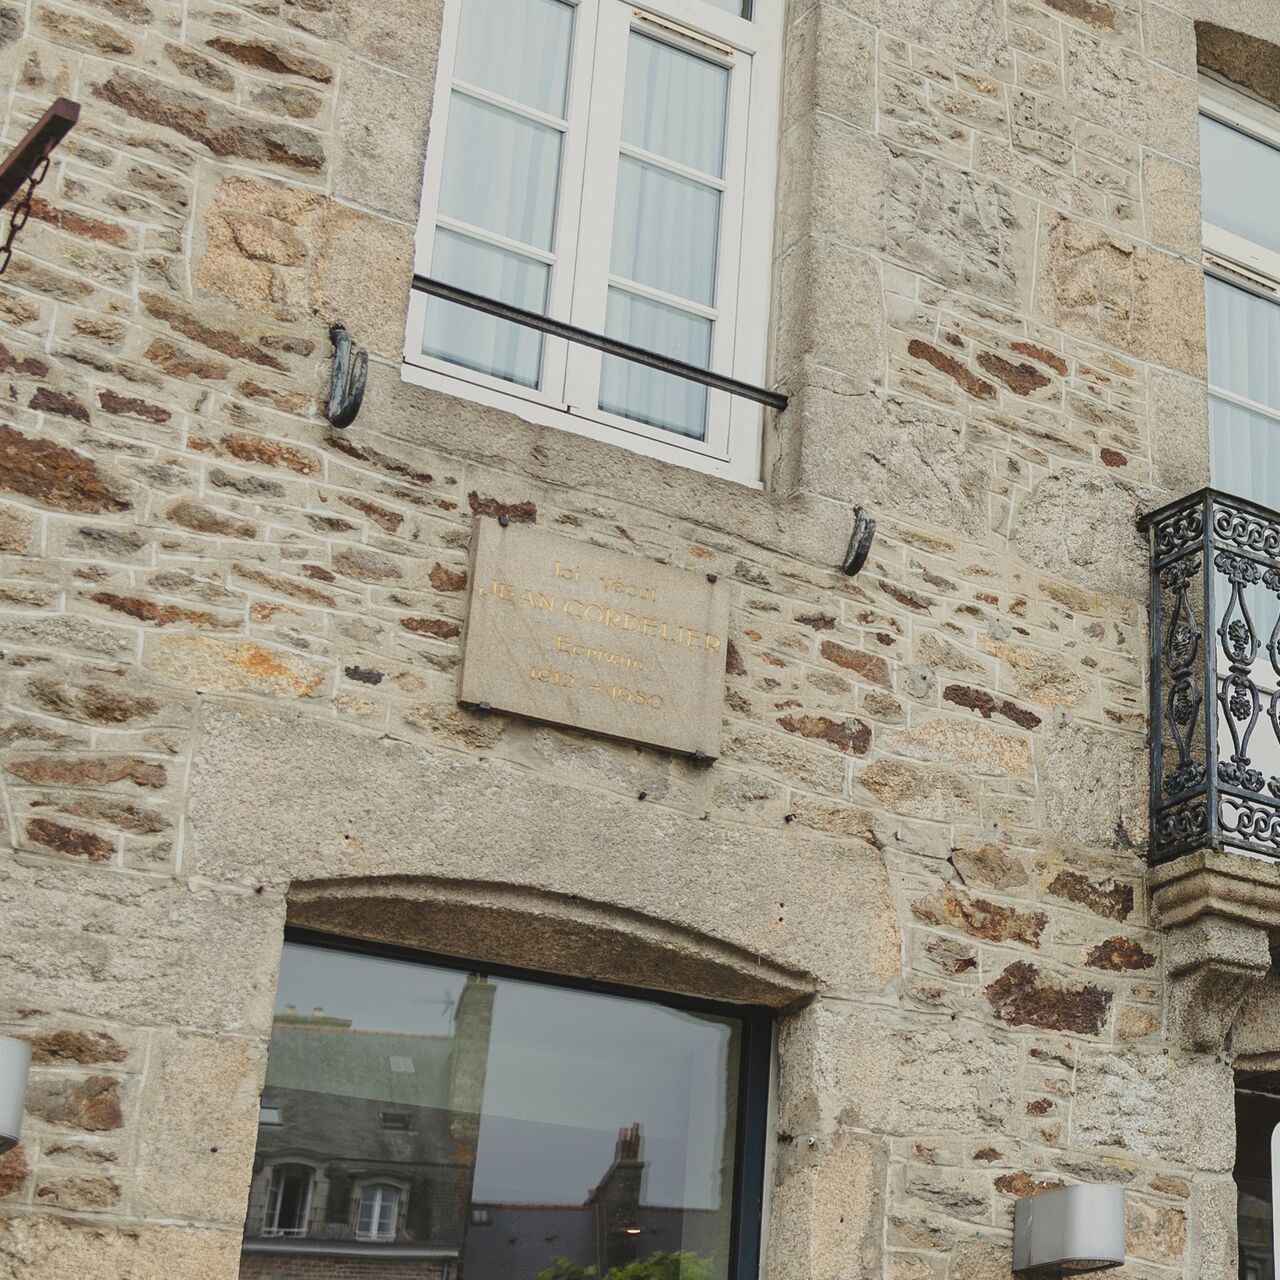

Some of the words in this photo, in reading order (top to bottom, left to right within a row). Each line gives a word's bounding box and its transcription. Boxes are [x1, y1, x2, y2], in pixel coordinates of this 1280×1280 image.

[554, 561, 580, 581] Ici
[478, 579, 555, 612] JEAN
[563, 598, 721, 653] CORDELIER
